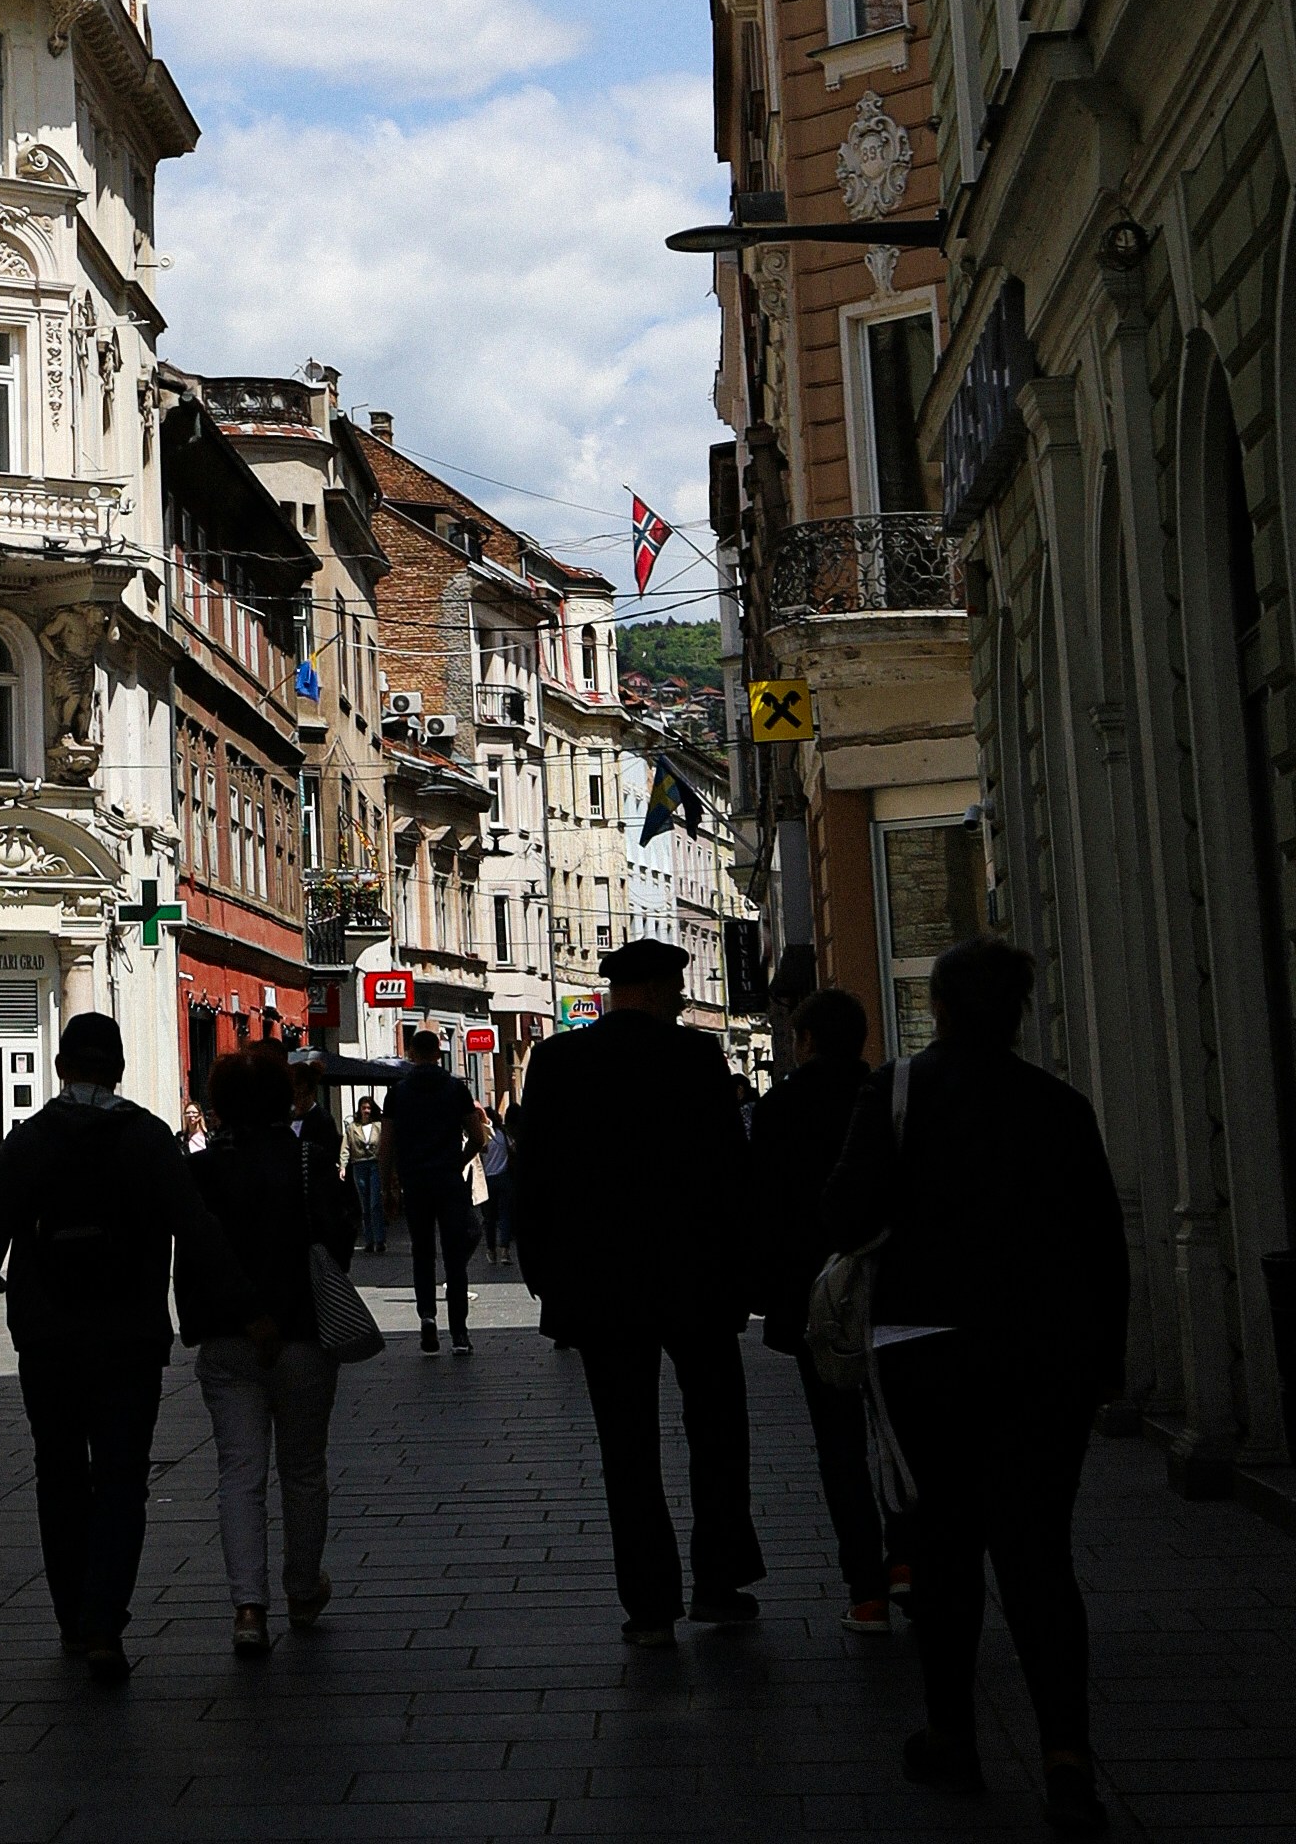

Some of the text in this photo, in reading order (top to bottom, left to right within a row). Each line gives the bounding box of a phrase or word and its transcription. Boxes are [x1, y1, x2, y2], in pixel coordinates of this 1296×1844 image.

[20, 954, 45, 970] GRAD
[375, 978, 406, 995] cm
[573, 999, 594, 1012] dm
